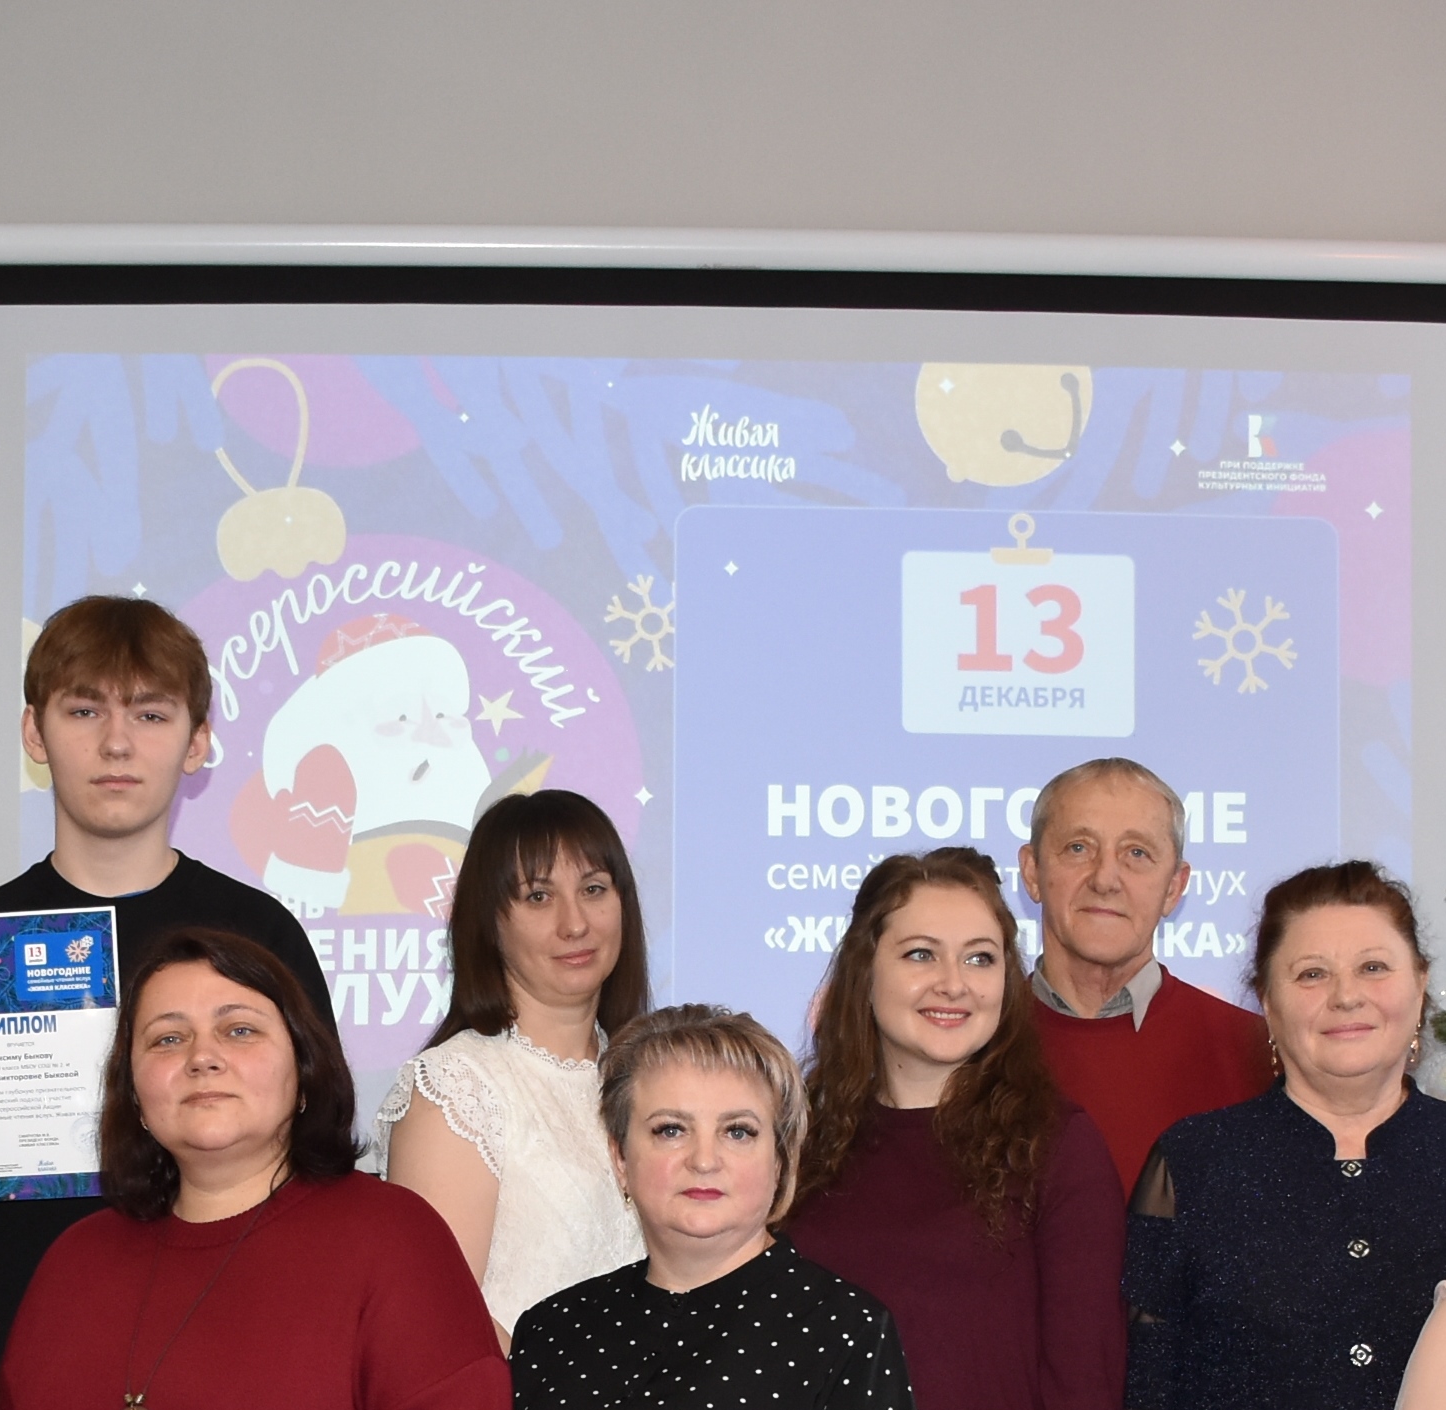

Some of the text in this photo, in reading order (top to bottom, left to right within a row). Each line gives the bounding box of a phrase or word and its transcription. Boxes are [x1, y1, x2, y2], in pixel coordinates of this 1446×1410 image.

[681, 404, 779, 448] Живая
[681, 453, 796, 483] классика
[1198, 471, 1326, 482] ПРЕЗИДЕНТСКОГО ФОНДА
[1220, 461, 1304, 471] ПРИ ПОДДЕРЖКЕ
[957, 584, 1085, 674] 13
[958, 686, 1086, 712] ДЕКАБРЯ
[767, 784, 1247, 843] НОВОГОЕ
[28, 946, 42, 957] 13
[309, 929, 453, 971] ЕНИЯ
[27, 966, 91, 978] НОВОГОДНИЕ
[55, 983, 90, 991] КЛАССИКА»
[331, 973, 454, 1026] ЛУХ
